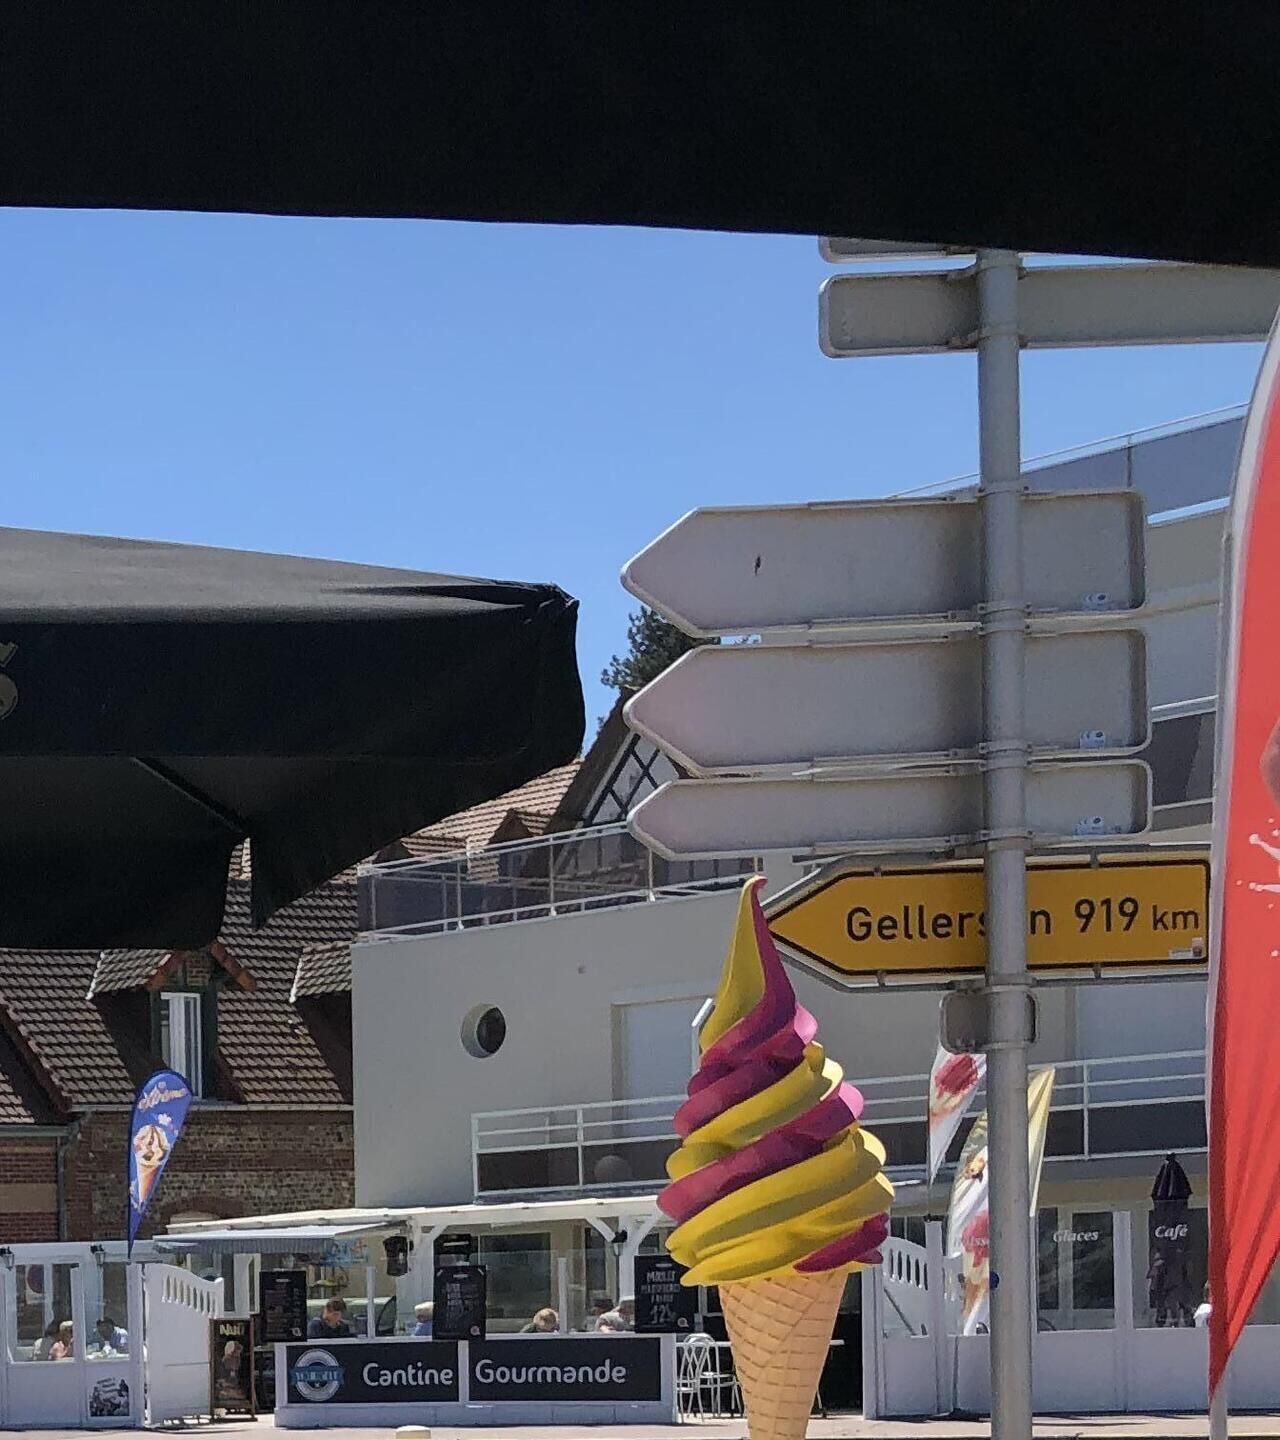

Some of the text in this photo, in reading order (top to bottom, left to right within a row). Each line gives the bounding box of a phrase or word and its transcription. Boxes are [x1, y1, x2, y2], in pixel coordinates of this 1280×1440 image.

[846, 897, 1200, 942] Gellern 919 km
[1052, 1229, 1099, 1243] Glaces
[1154, 1223, 1189, 1241] Café
[362, 1362, 454, 1386] Cantine
[475, 1359, 627, 1385] Gourmande
